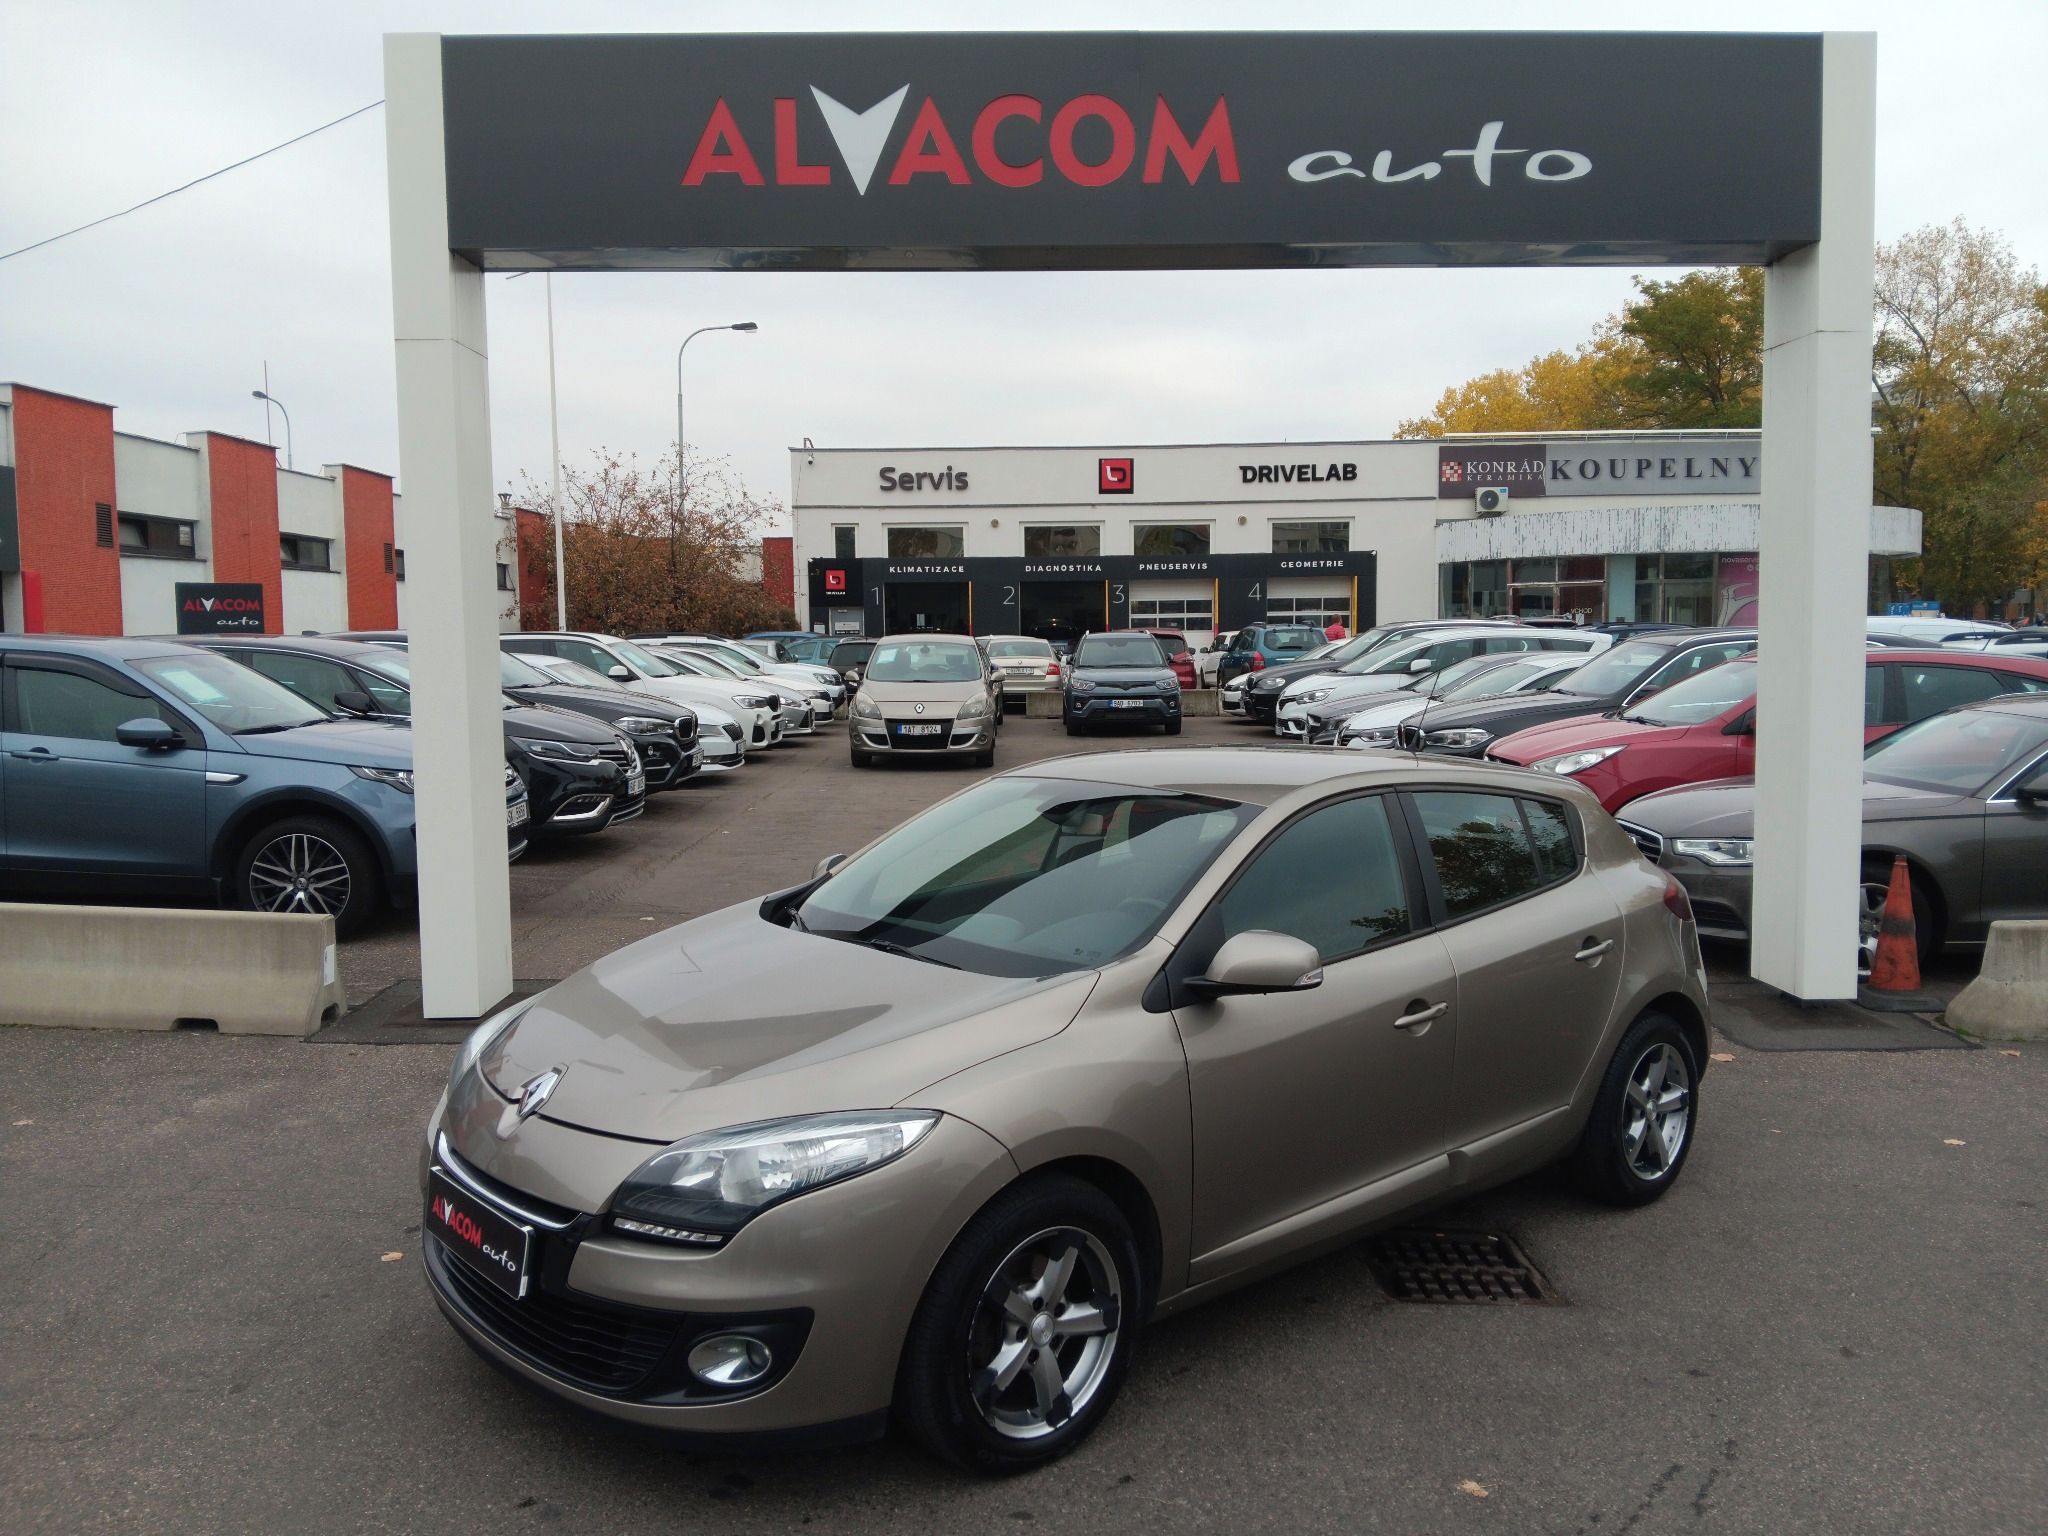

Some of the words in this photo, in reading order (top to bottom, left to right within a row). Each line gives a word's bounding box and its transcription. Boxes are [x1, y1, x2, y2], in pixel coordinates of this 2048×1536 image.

[681, 83, 1241, 197] ALVACOM
[1287, 121, 1593, 187] auto
[1239, 463, 1358, 483] DRIVELAB
[1466, 459, 1544, 474] KONRÁD
[1551, 457, 1758, 480] KOUPELNY
[879, 465, 969, 491] Servis
[1281, 560, 1344, 568] GEOMETRIE
[871, 587, 879, 605] 1
[1002, 586, 1016, 605] 2
[1112, 584, 1125, 604] 3
[1248, 582, 1262, 601] 4
[184, 597, 260, 612] ALVACOM
[216, 616, 259, 626] auto
[432, 1195, 482, 1249] ALVACOM
[482, 1244, 516, 1272] auto
